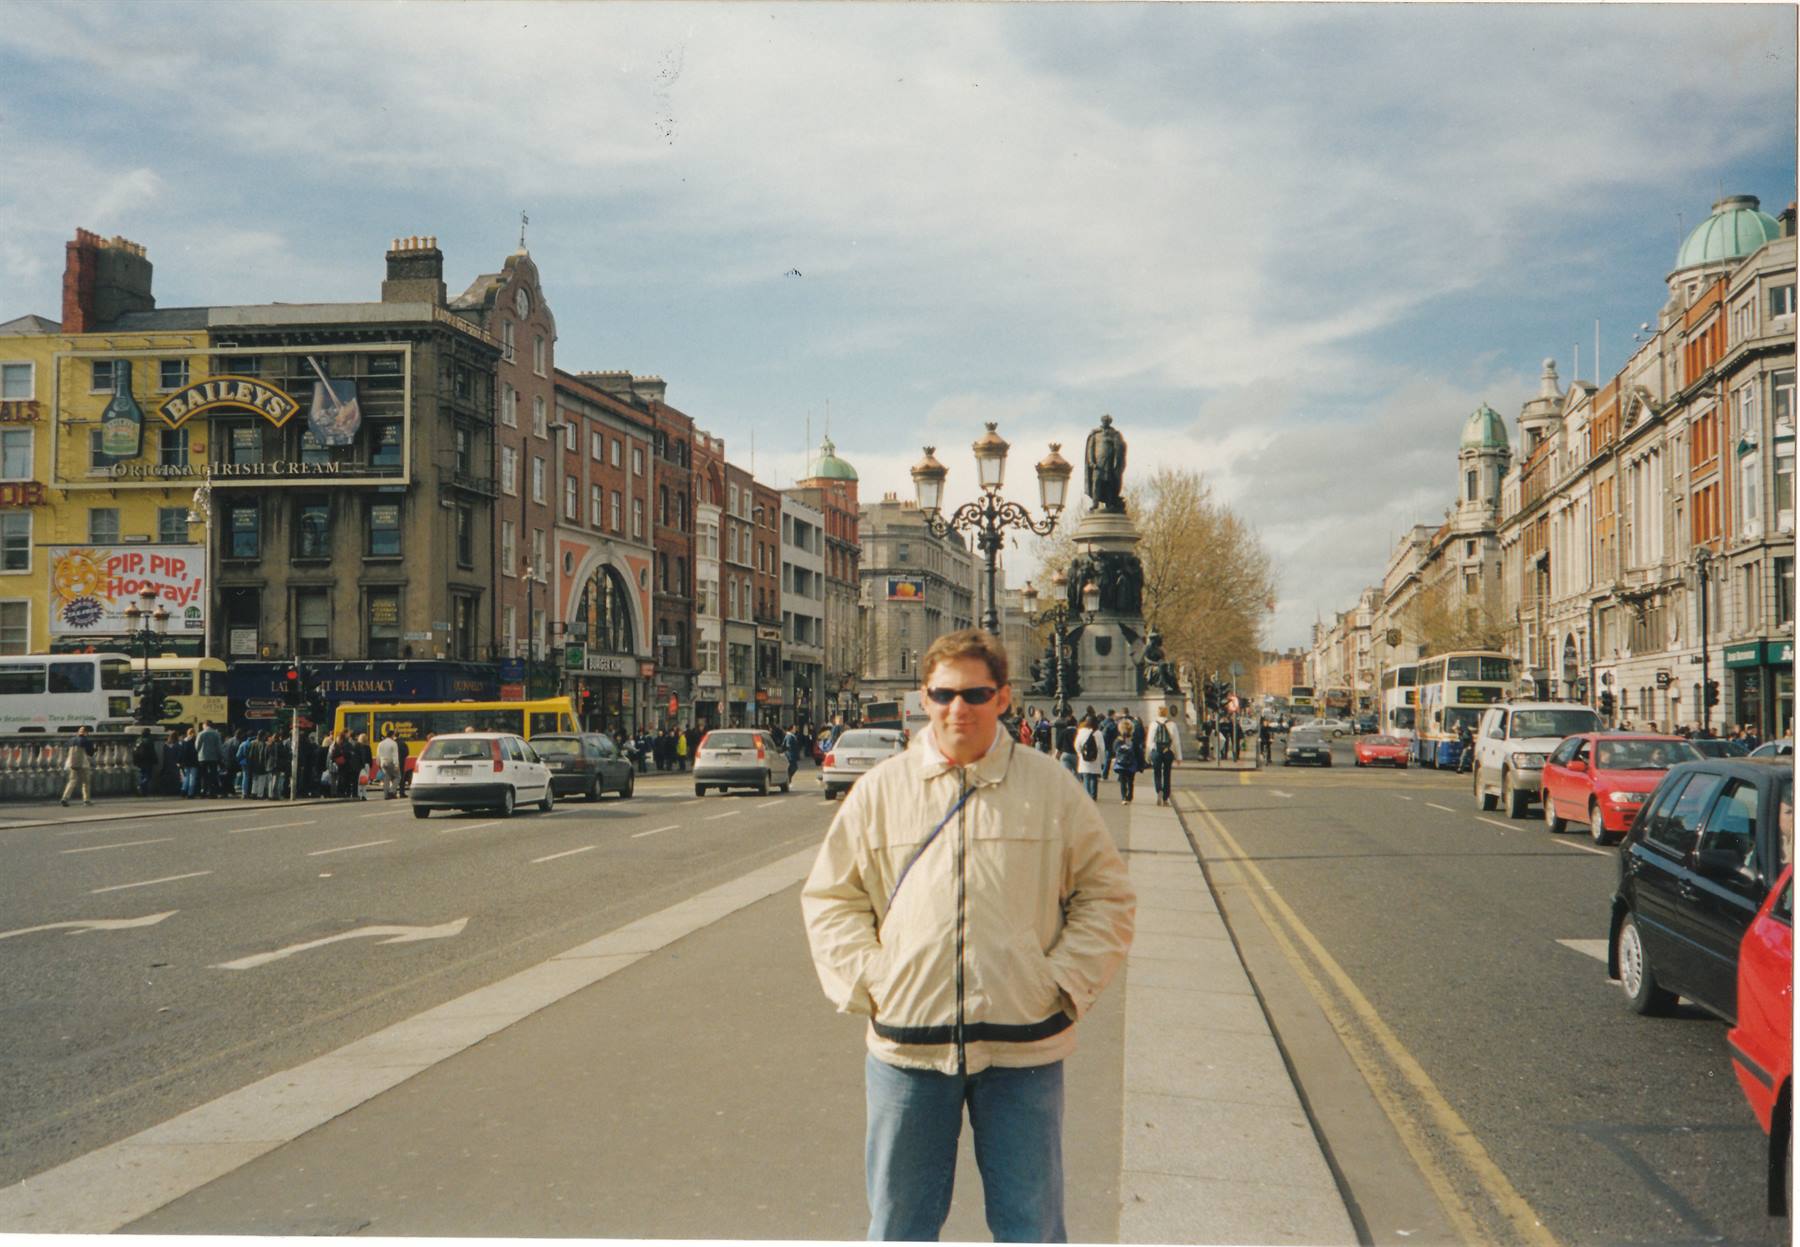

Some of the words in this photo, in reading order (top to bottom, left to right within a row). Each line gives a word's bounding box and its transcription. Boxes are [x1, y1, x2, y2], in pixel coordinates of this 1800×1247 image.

[164, 380, 285, 420] BAILEYS
[212, 460, 265, 475] IRISH
[271, 459, 339, 475] CREAM
[107, 552, 145, 578] PIP,
[150, 553, 188, 581] PIP,
[106, 576, 202, 608] Hooray!
[335, 679, 394, 692] PHARMACY
